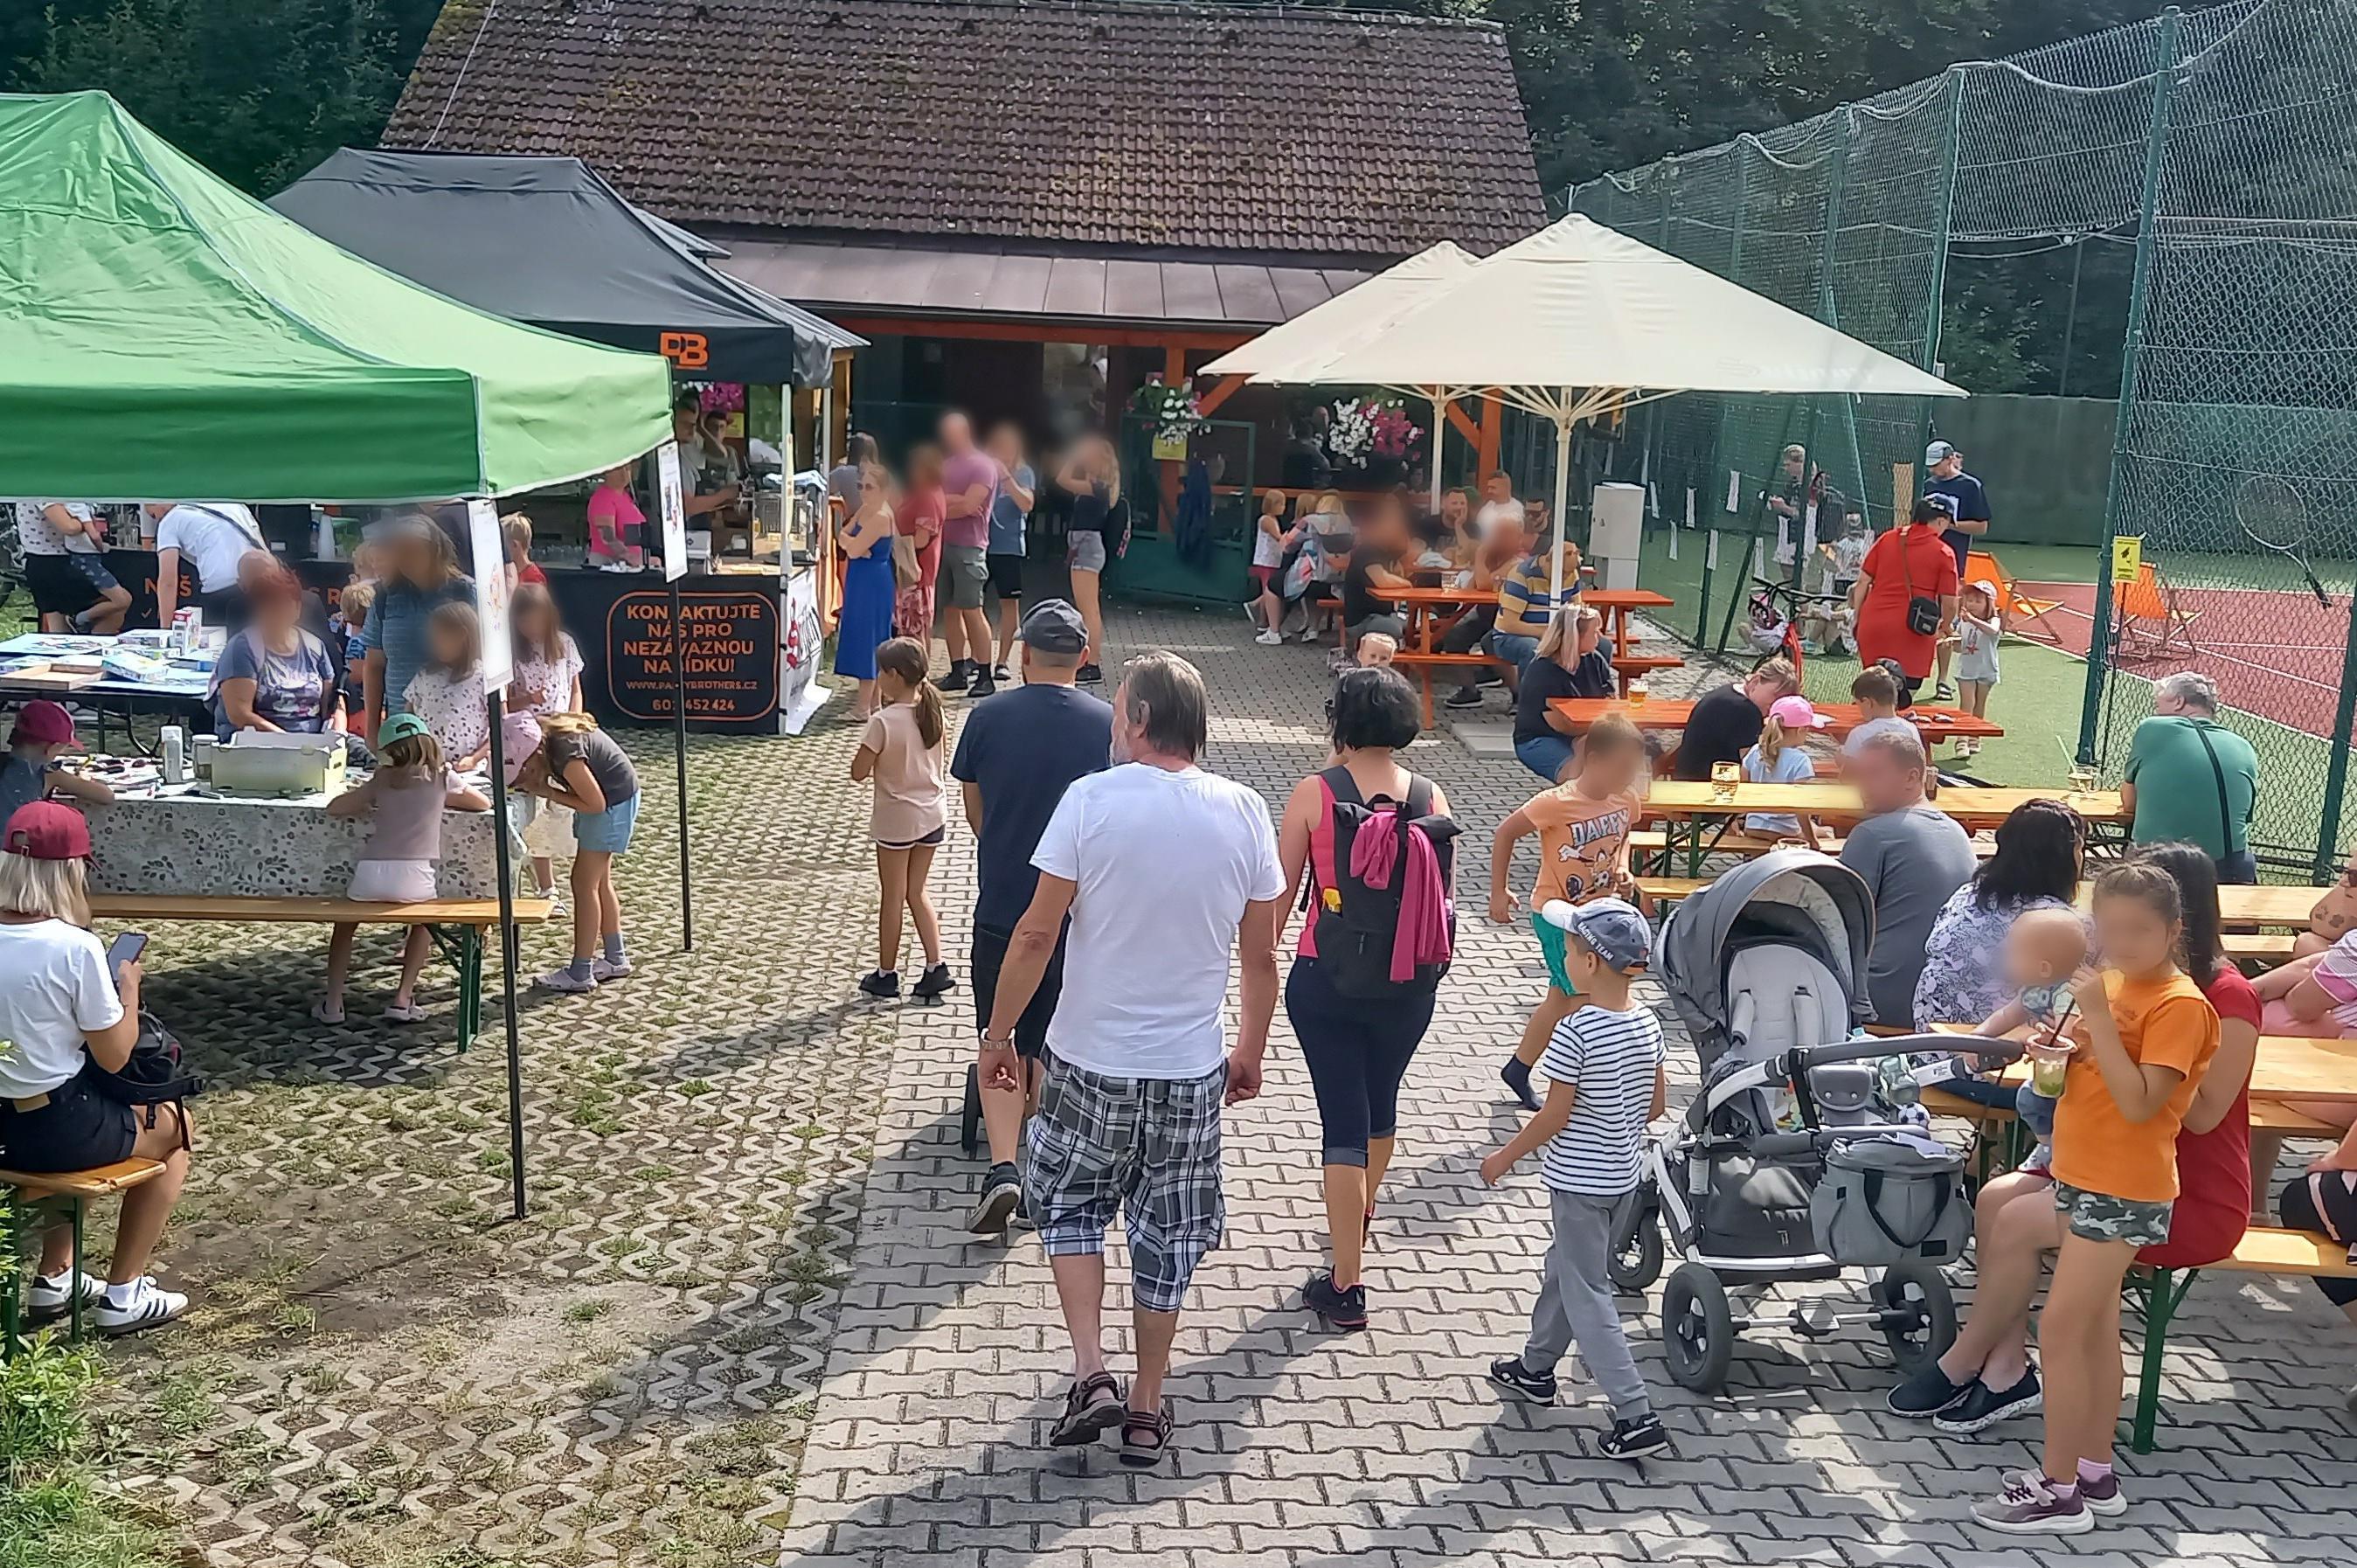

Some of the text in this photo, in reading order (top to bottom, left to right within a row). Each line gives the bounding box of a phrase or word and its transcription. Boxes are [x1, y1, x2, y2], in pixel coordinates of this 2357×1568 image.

[144, 573, 192, 597] NŠ
[627, 604, 761, 621] KONAKTUJTE
[693, 622, 732, 638] PRO
[643, 655, 735, 674] NAÍDKU!
[626, 680, 757, 690] WWW.PAYBROTHERS.CZ
[652, 698, 736, 711] 60 452 424
[1570, 808, 1629, 847] DAFFY
[1594, 942, 1615, 961] TEAM
